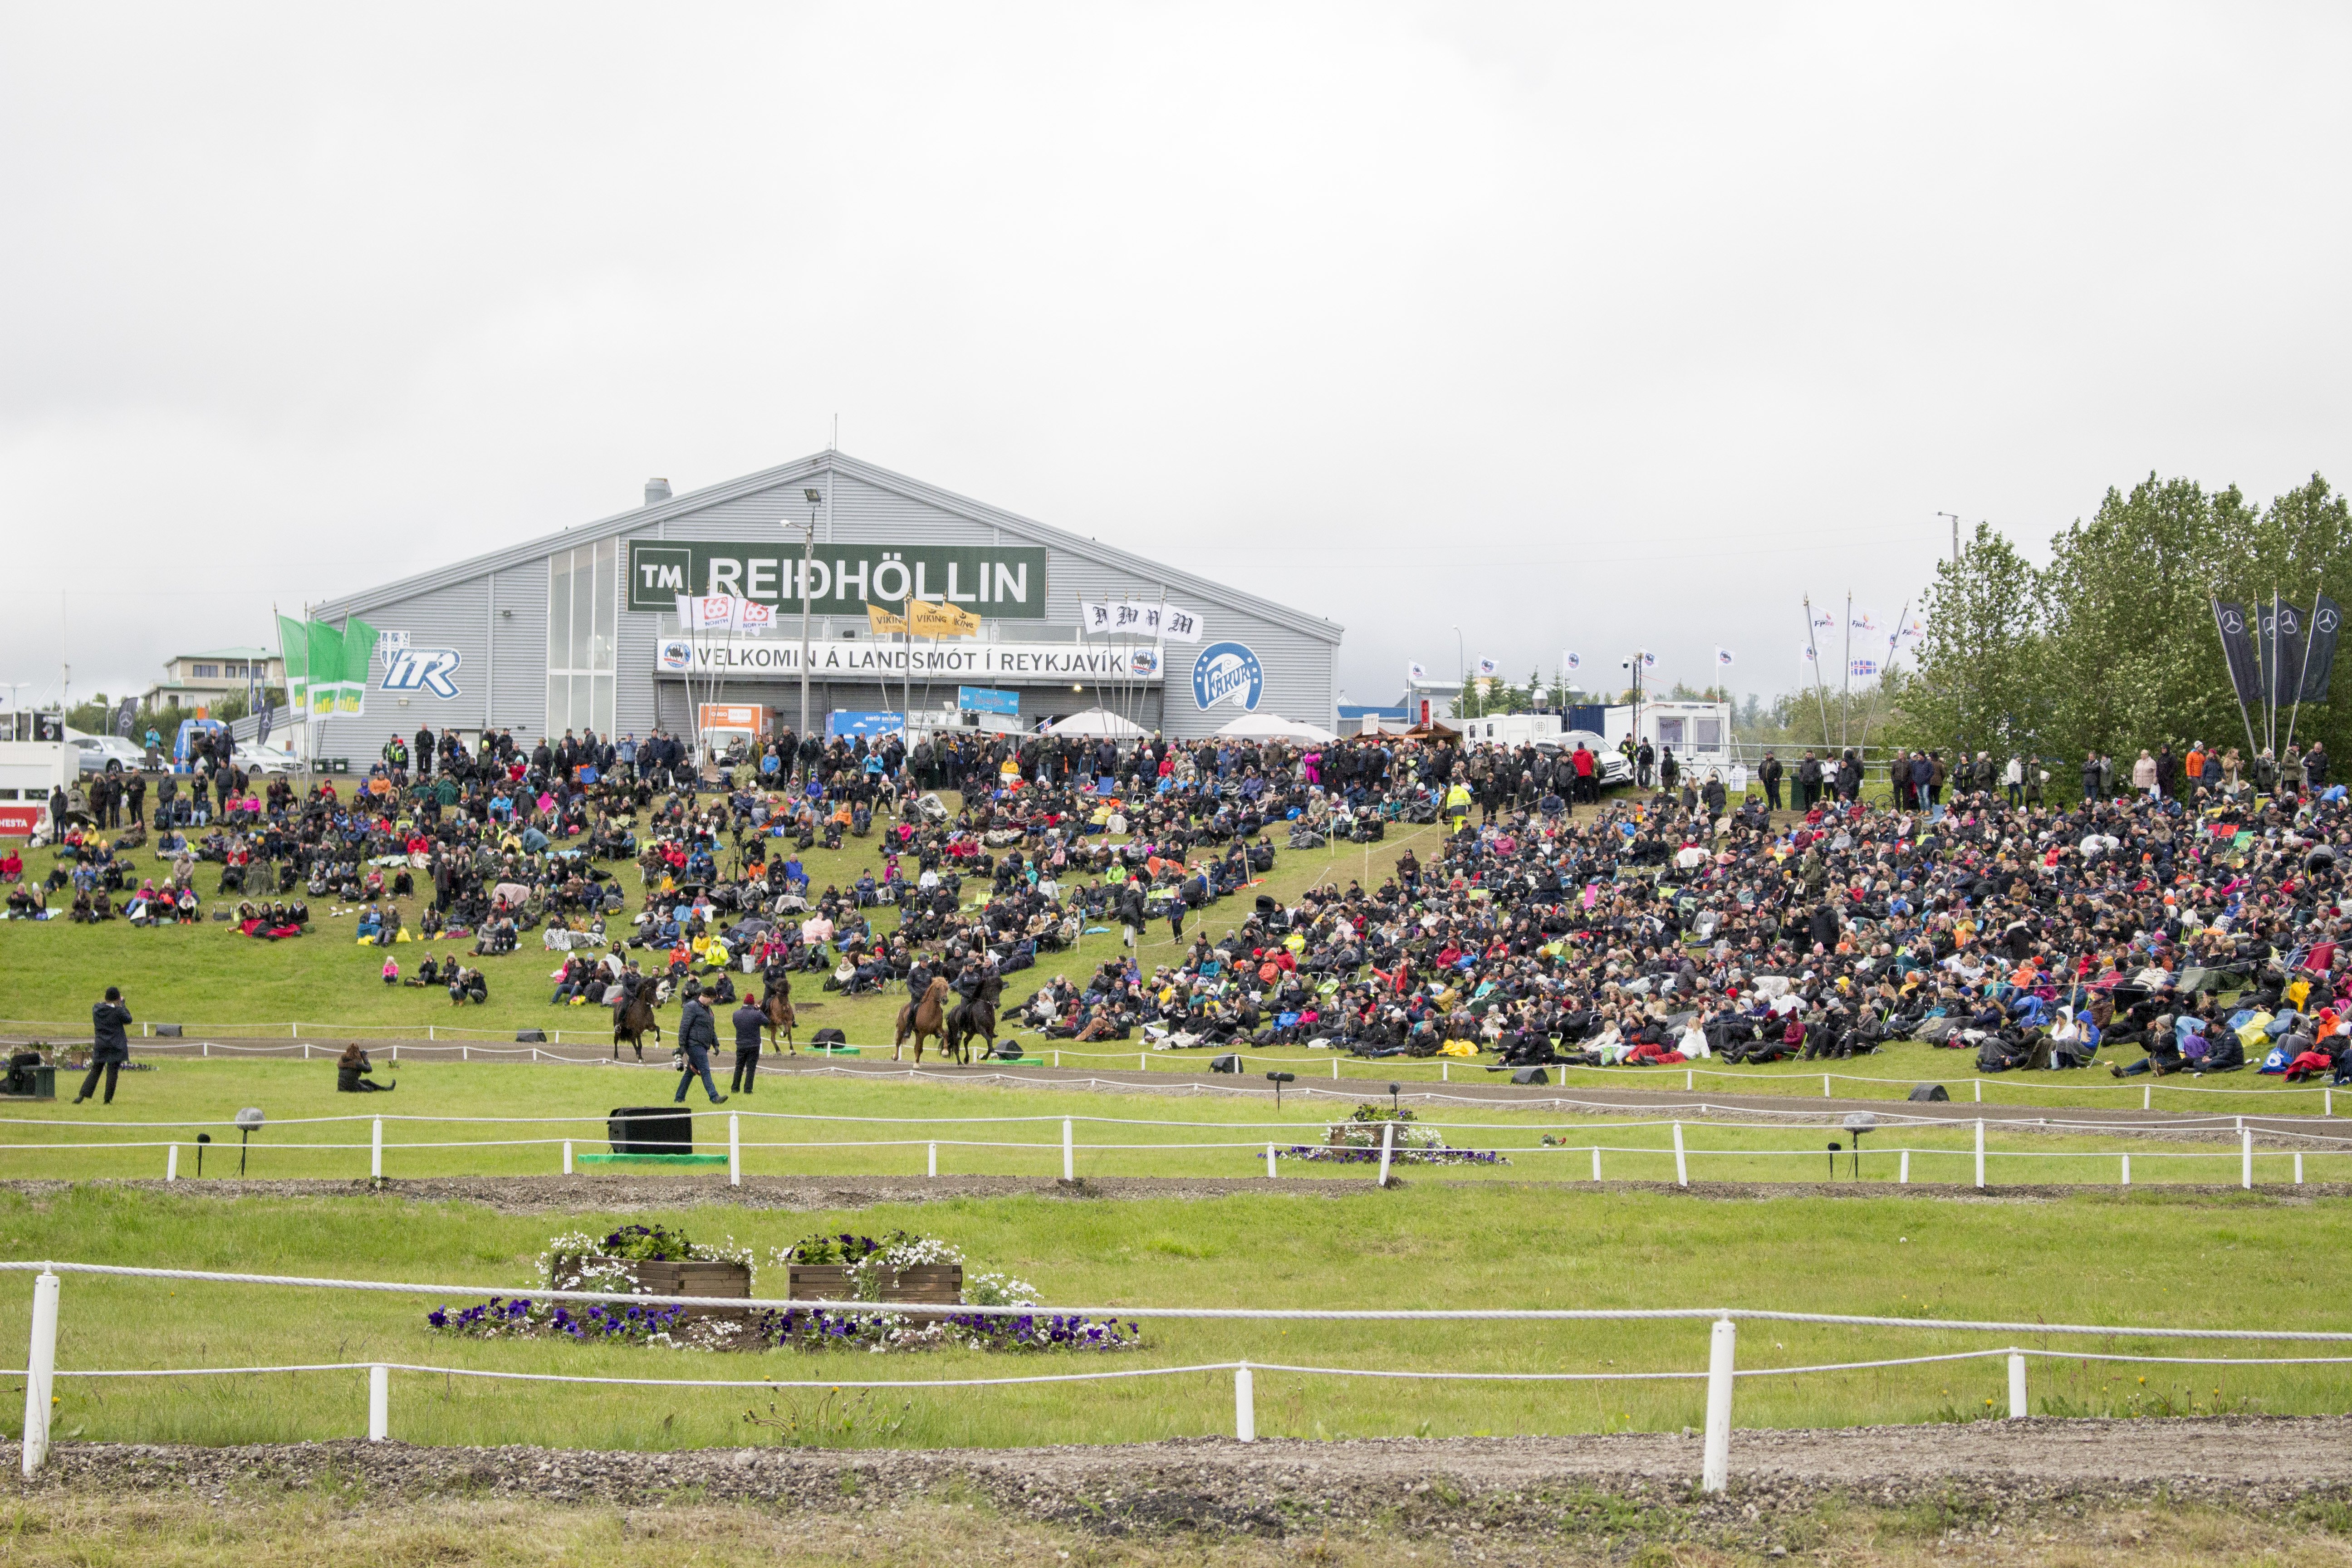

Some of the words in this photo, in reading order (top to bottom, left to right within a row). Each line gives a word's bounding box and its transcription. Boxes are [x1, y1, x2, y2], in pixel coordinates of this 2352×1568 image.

[641, 564, 683, 588] TM
[709, 552, 1027, 603] REIÐHÖLLIN
[705, 618, 729, 627] NORTH
[916, 613, 947, 623] VÍKING
[952, 616, 974, 628] ÍKING
[1117, 606, 1139, 627] M
[1168, 612, 1194, 635] M
[698, 648, 816, 667] VELKOMIN
[825, 646, 840, 668] Á
[849, 648, 977, 670] LANDSMÓT
[986, 648, 992, 670] Í
[1001, 650, 1123, 672] REYKJAVÍK
